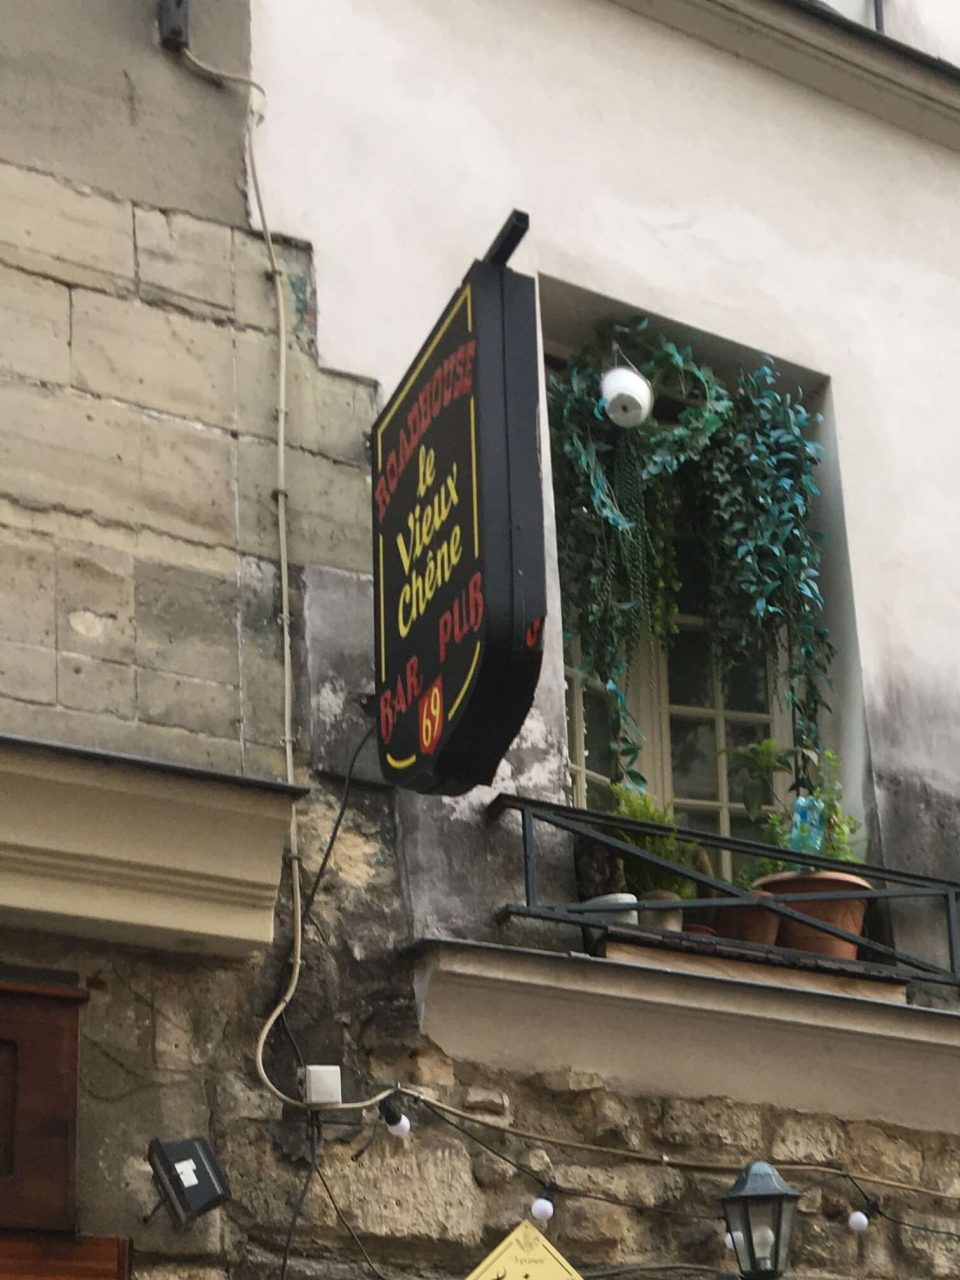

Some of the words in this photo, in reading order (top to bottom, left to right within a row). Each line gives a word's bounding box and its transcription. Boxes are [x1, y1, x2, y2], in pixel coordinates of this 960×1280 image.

[374, 338, 478, 524] ROADHOUSE
[416, 442, 437, 499] le
[395, 460, 460, 577] Vieux
[379, 655, 423, 746] BAR
[438, 571, 484, 664] PUB
[421, 685, 441, 748] 69
